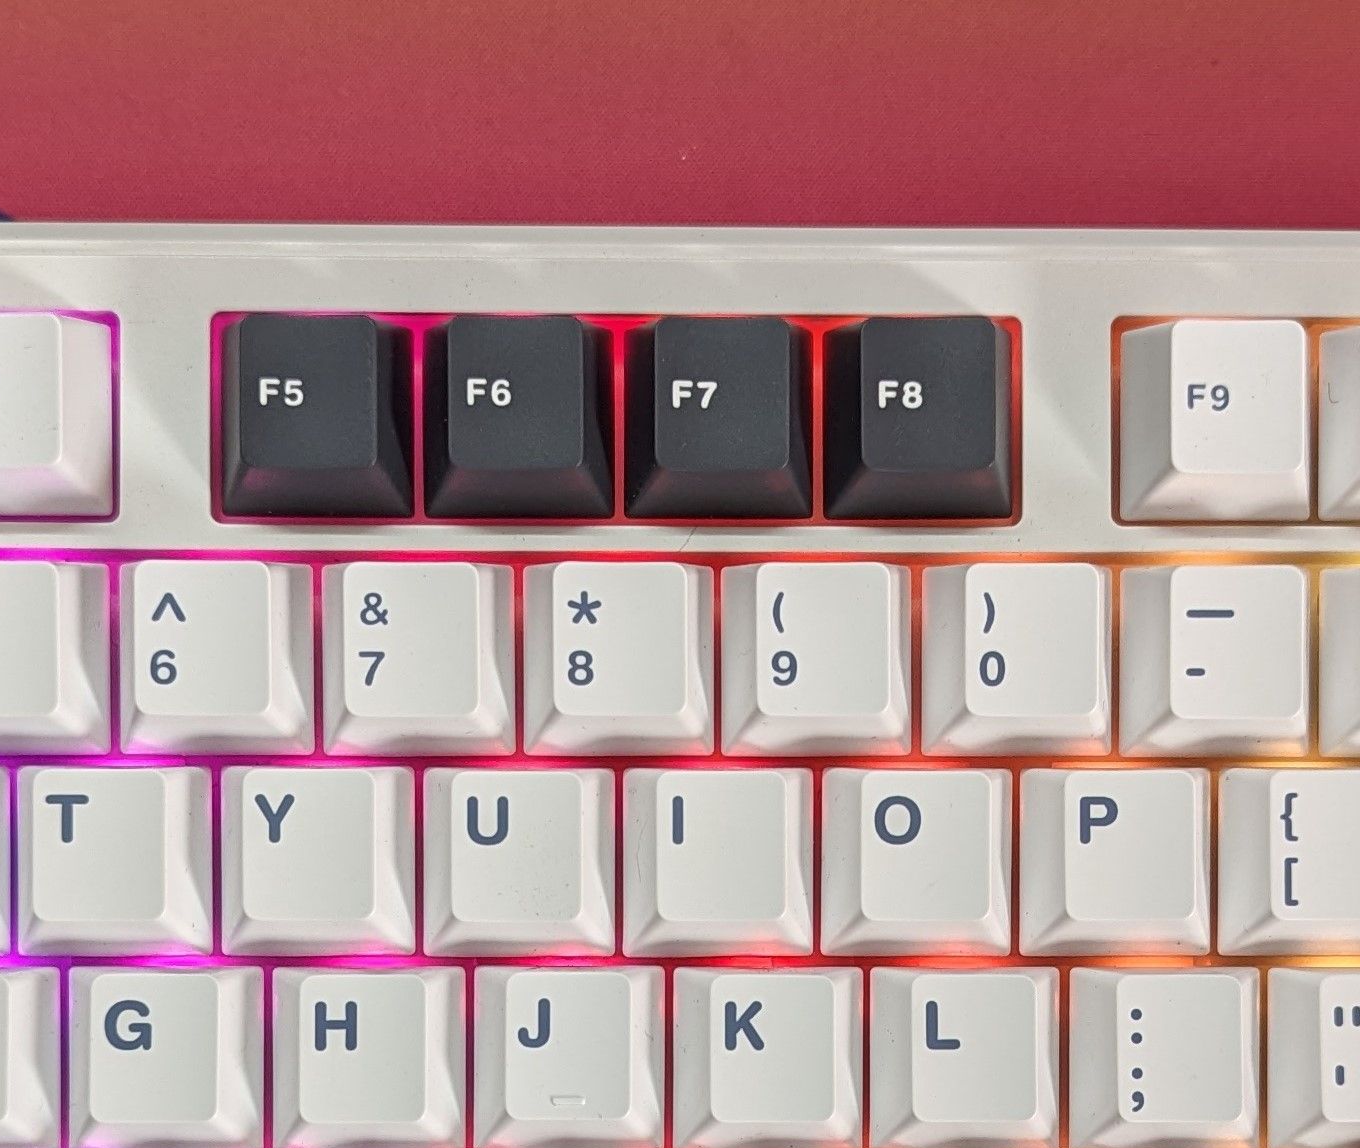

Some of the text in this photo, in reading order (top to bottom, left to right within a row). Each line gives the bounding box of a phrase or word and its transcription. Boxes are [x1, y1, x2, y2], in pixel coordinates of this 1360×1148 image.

[260, 379, 303, 406] F5
[467, 379, 511, 406] F6
[673, 380, 717, 408] F7
[879, 381, 922, 408] F8
[1188, 384, 1229, 411] F9
[360, 593, 388, 625] &
[773, 592, 784, 633] (
[984, 593, 995, 633] )
[150, 650, 177, 684] 6
[359, 652, 385, 686] 7
[568, 650, 593, 685] 8
[772, 651, 797, 686] 9
[980, 651, 1005, 686] 0
[45, 795, 89, 843] T
[255, 794, 294, 843] Y
[467, 796, 508, 845] U
[673, 796, 683, 844] I
[875, 796, 921, 845] O
[1080, 796, 1118, 844] P
[1280, 793, 1298, 841] {
[1285, 858, 1298, 906] [
[105, 1000, 152, 1050] G
[315, 1001, 357, 1051] H
[518, 998, 550, 1048] J
[725, 1001, 764, 1050] K
[926, 1001, 960, 1050] L
[1131, 1009, 1142, 1044] :
[1132, 1068, 1144, 1112] ;
